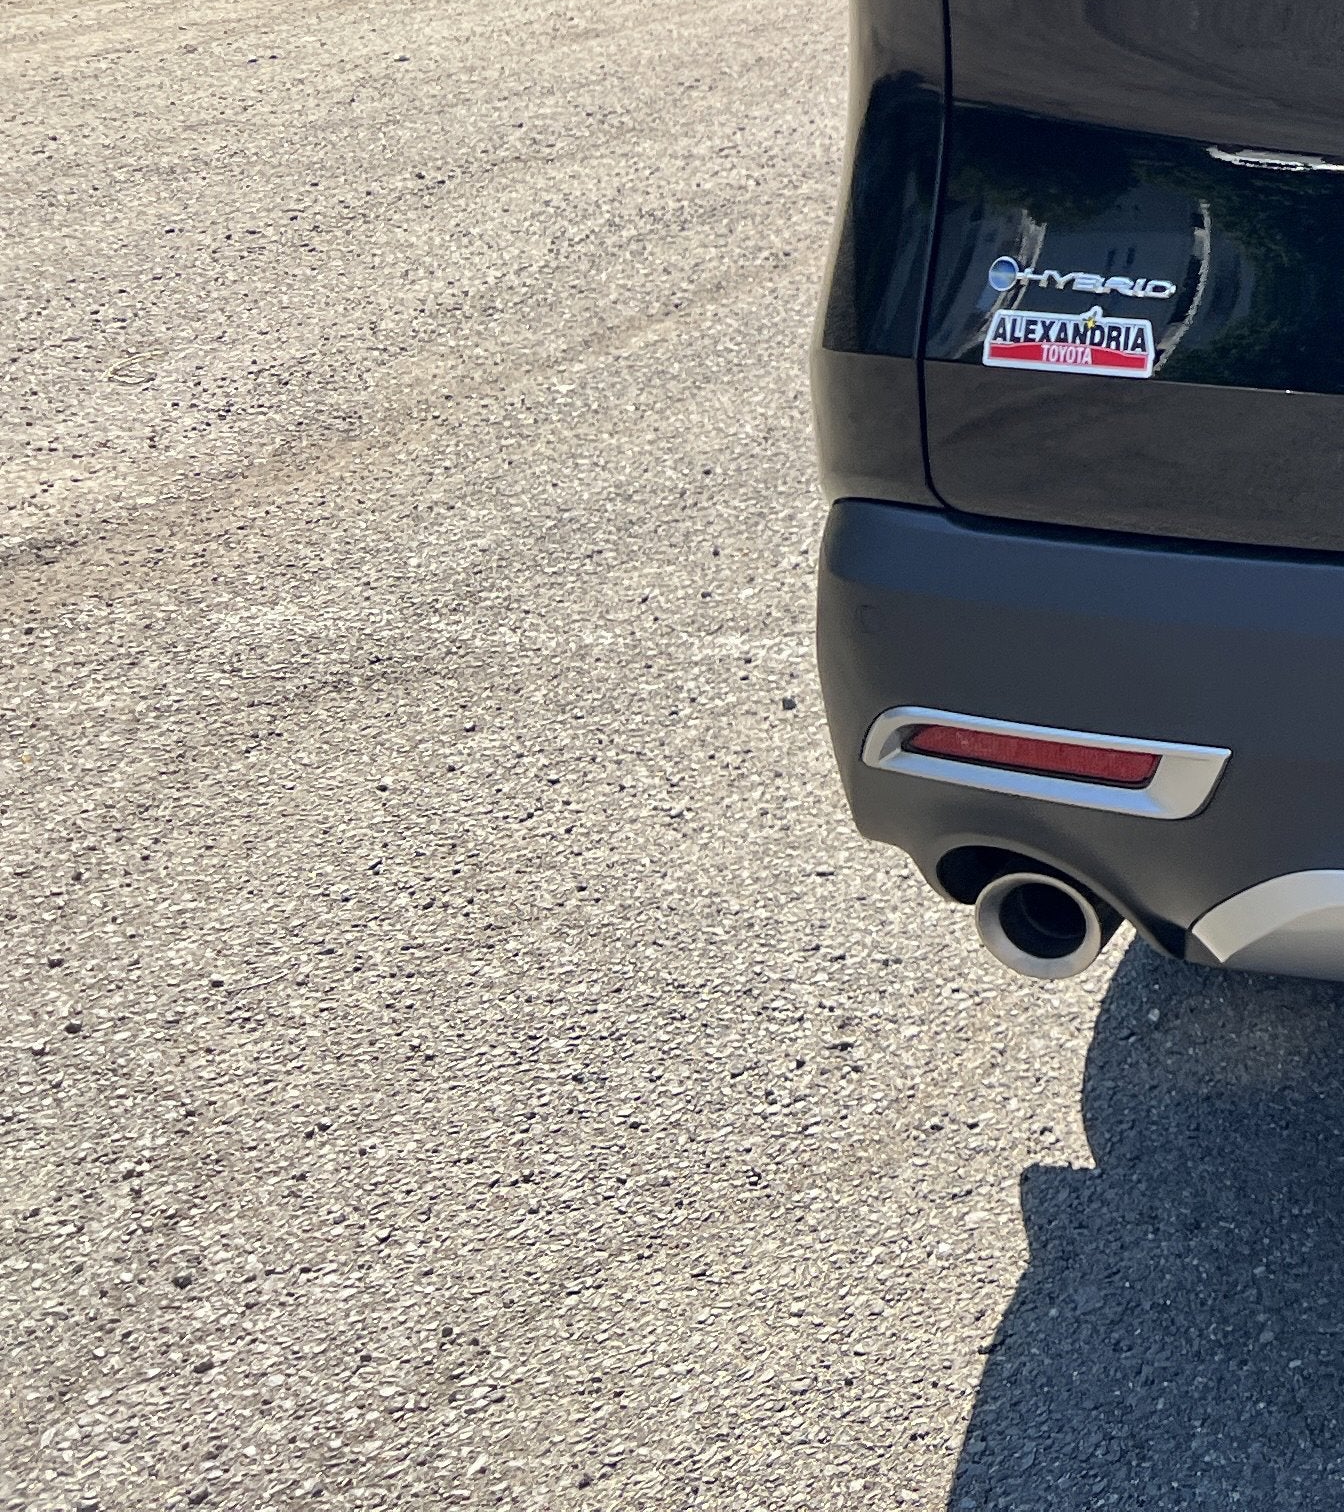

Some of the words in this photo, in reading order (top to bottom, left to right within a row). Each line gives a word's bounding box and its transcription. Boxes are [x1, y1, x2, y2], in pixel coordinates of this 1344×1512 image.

[1016, 266, 1177, 299] HYBRID
[993, 317, 1148, 353] ALEXANDRIA
[1041, 344, 1092, 365] TOYOTA
